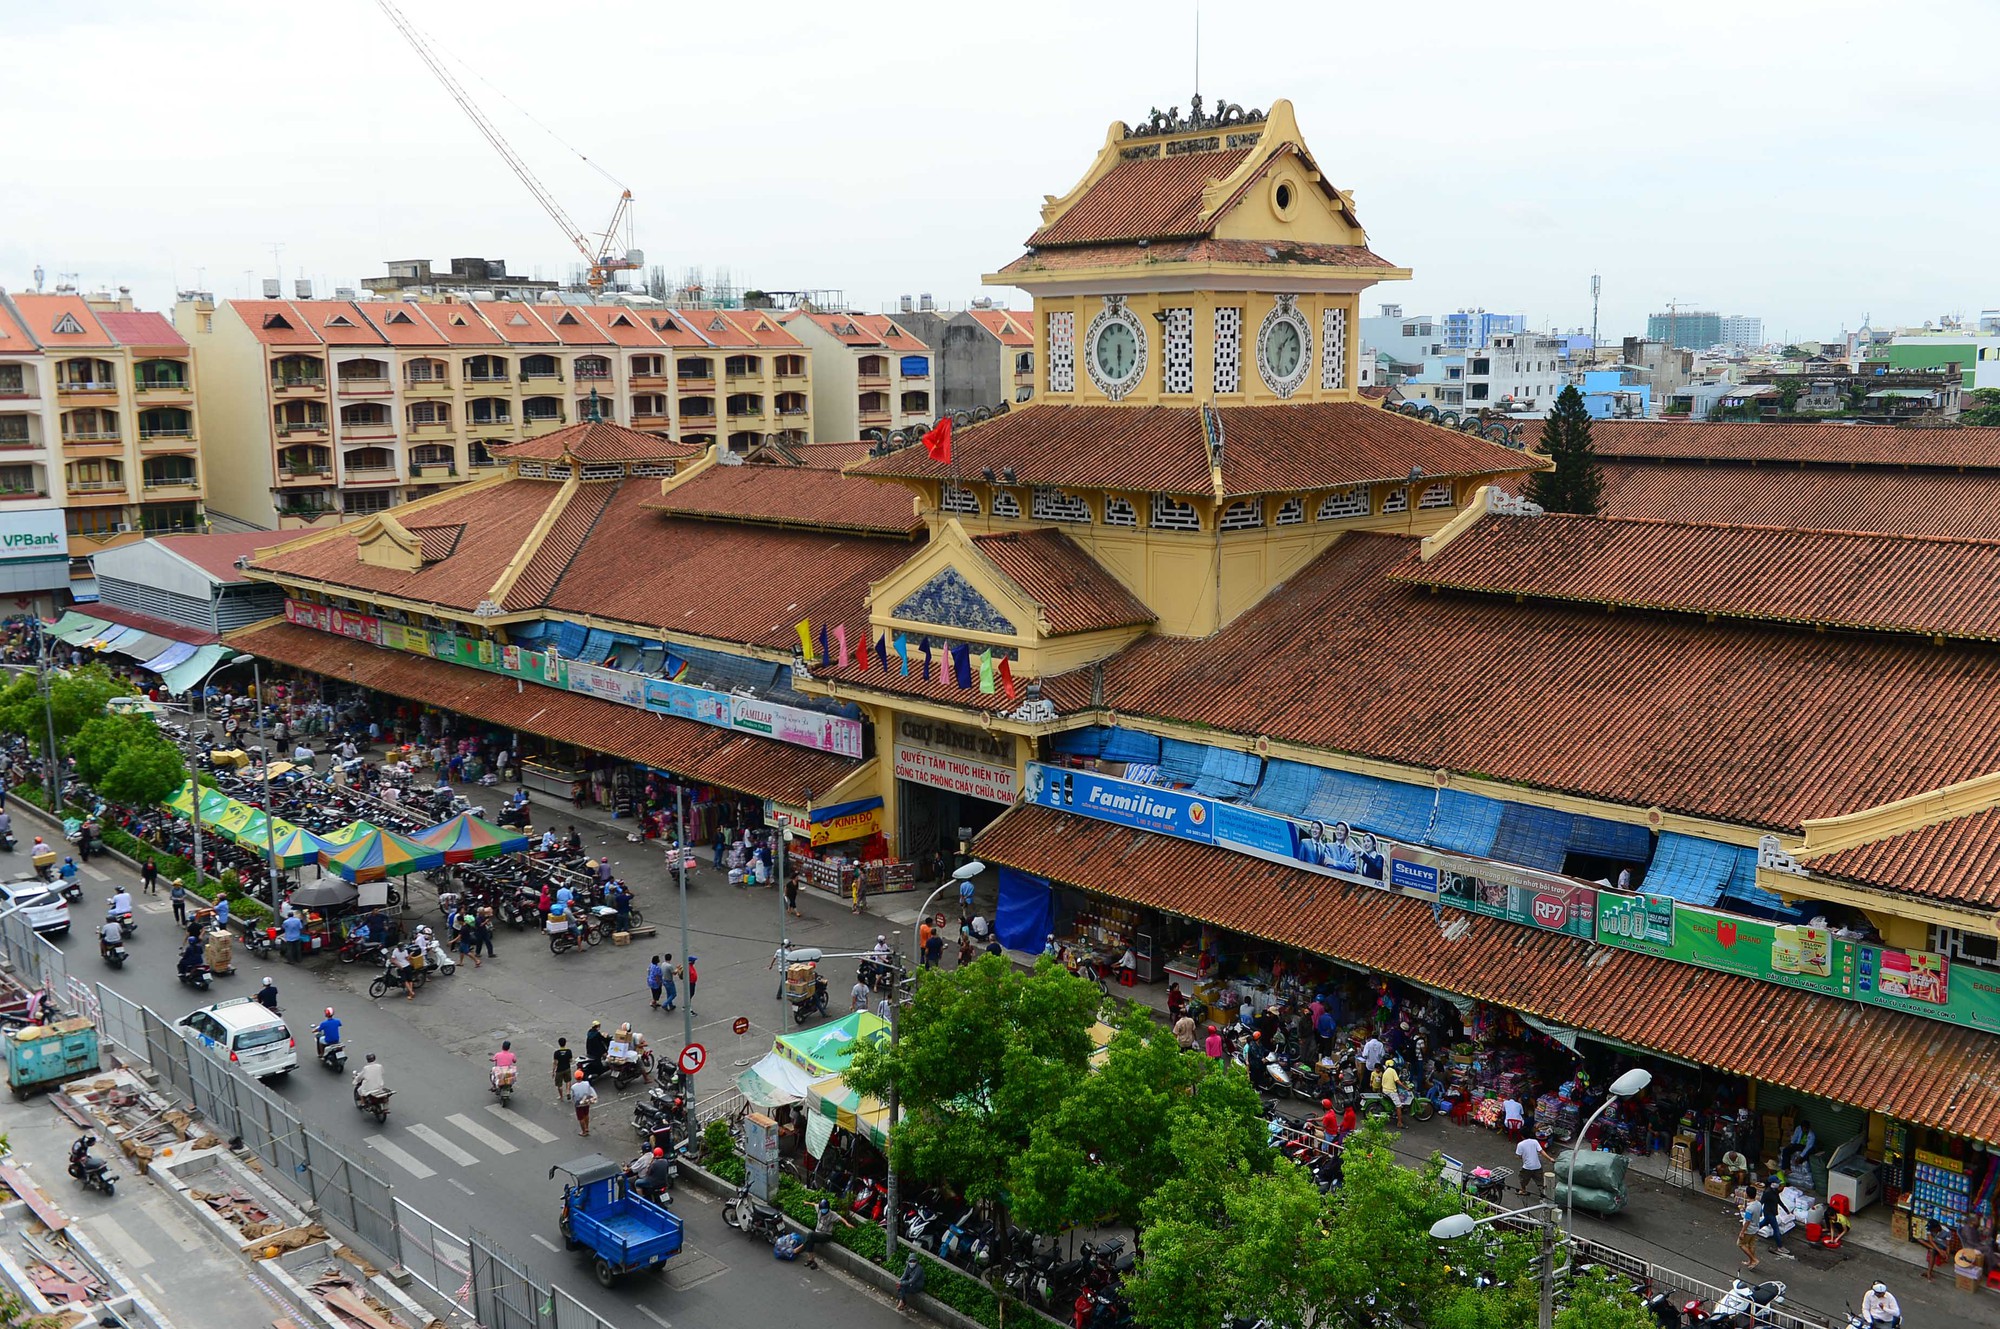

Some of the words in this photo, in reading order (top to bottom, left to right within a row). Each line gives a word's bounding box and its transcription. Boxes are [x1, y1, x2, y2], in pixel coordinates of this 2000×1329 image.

[3, 532, 59, 547] VPBank
[740, 707, 772, 724] FAMILIAR
[901, 750, 926, 766] QUYẾT
[928, 756, 946, 770] TÂM
[948, 761, 970, 777] THỰC
[972, 766, 992, 783] HIỆN
[994, 770, 1011, 786] TỐT
[895, 763, 914, 778] CÔNG
[915, 768, 928, 782] TÁC
[930, 773, 954, 789] PHÒNG
[955, 779, 974, 794] CHÁY
[996, 789, 1016, 804] CHÁY
[1088, 784, 1177, 820] Familiar
[835, 815, 858, 828] KINH
[1395, 863, 1434, 880] SELLEYS
[1551, 884, 1566, 895] trơn
[1535, 901, 1564, 921] RP7
[1580, 909, 1592, 918] RP7
[1693, 925, 1716, 935] EAGLE
[1738, 934, 1762, 945] BRAND
[1819, 984, 1833, 994] CON
[1973, 982, 2000, 994] EAGLE
